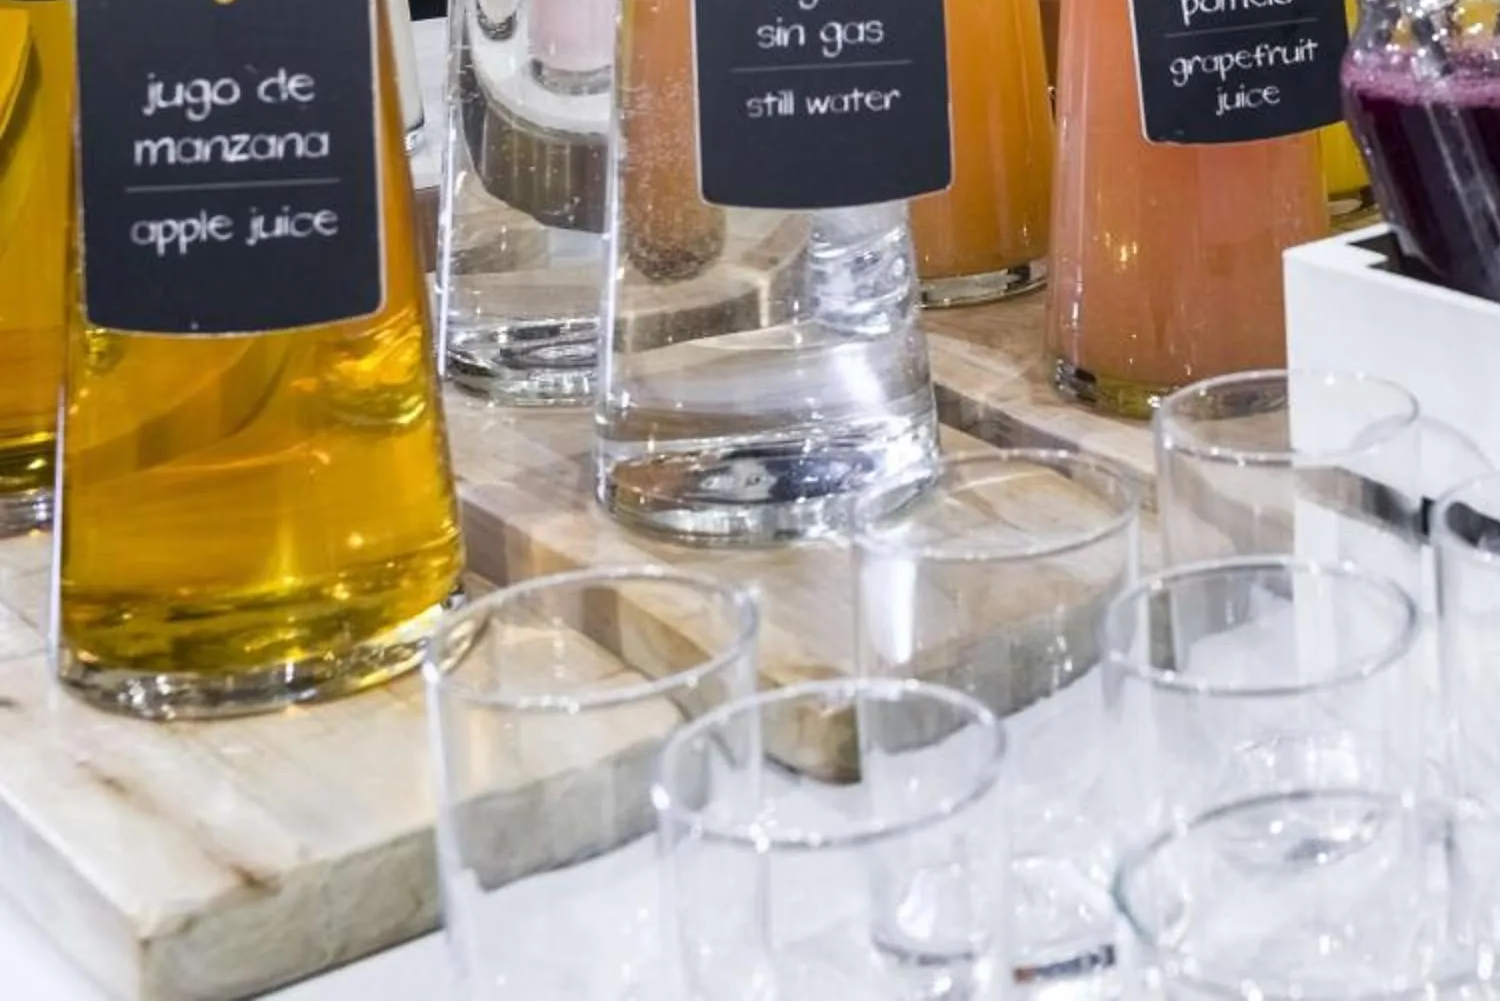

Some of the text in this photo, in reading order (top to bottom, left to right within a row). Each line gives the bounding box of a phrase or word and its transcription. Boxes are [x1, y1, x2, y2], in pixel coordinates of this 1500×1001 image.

[757, 17, 884, 57] sin gas
[1170, 39, 1318, 87] grapefruit
[143, 69, 314, 121] jugo de
[747, 88, 900, 116] still water
[1216, 84, 1280, 116] juice
[135, 132, 329, 164] manzana
[132, 207, 337, 255] apple juice
